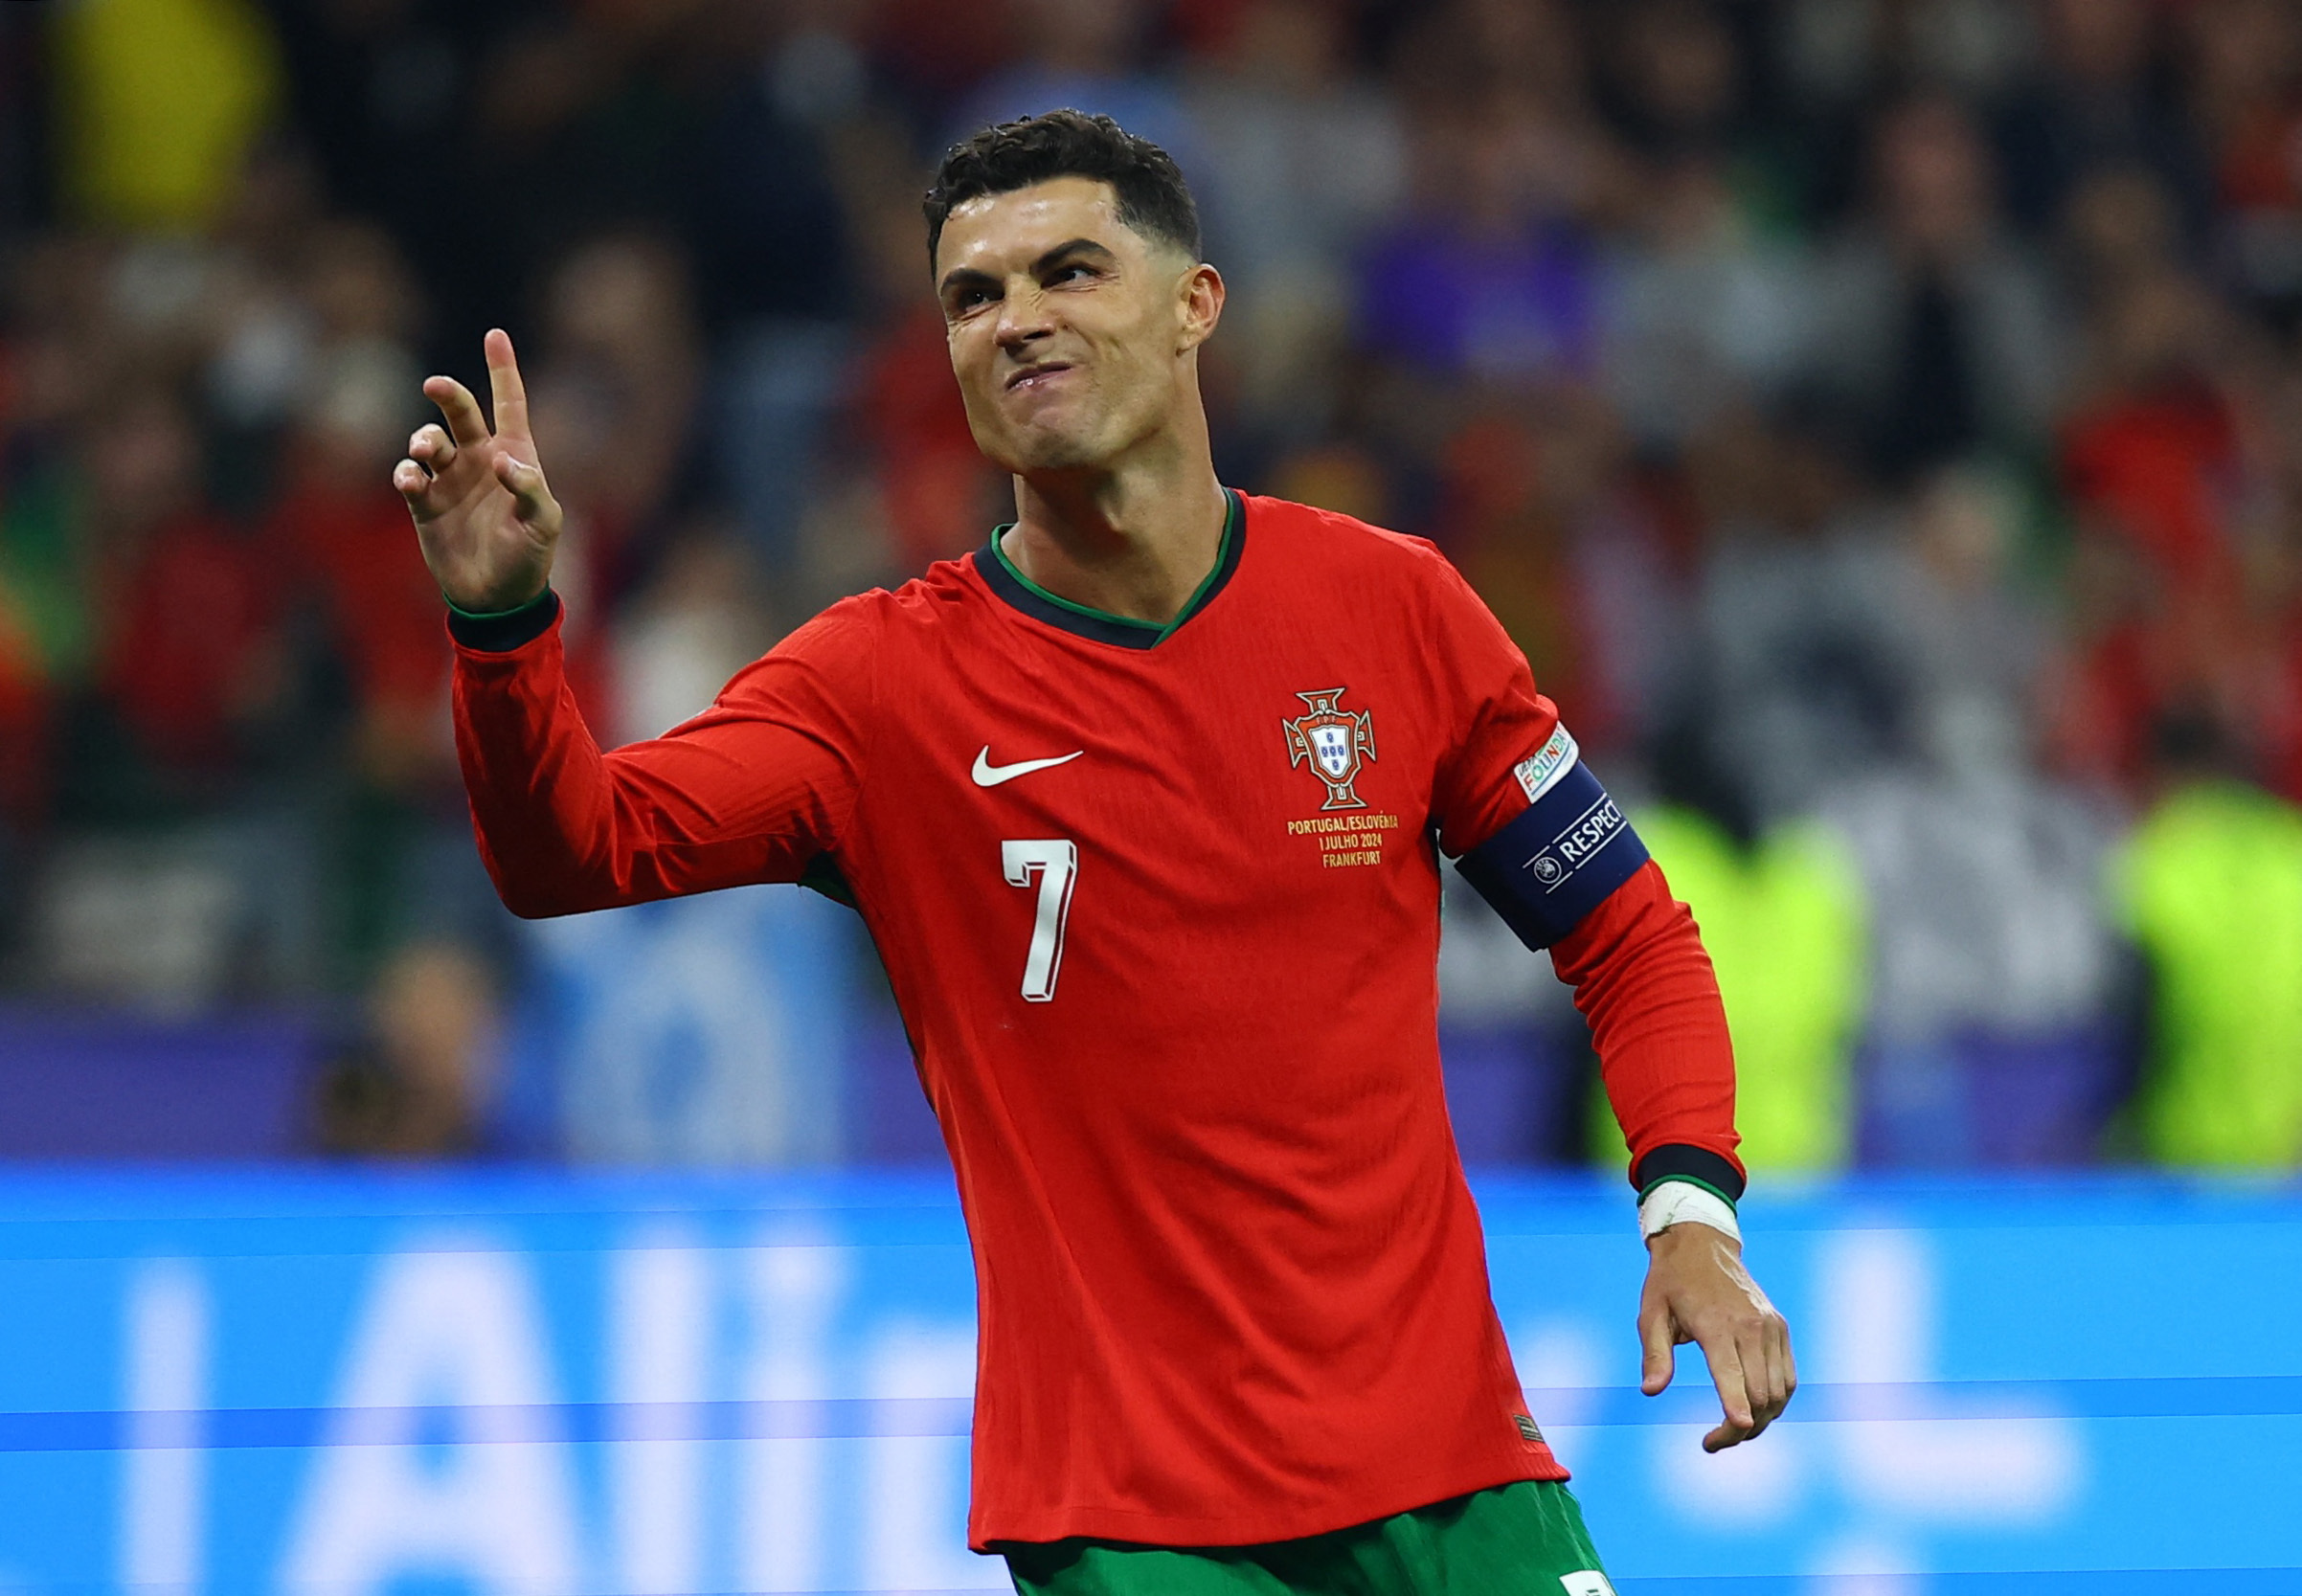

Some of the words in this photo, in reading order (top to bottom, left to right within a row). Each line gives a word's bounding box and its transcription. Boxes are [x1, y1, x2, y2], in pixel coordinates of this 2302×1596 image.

[1325, 834, 1359, 850] JULHO
[1361, 833, 1382, 848] 2024
[1559, 799, 1622, 863] RESPECT
[1322, 850, 1381, 868] FRANKFURT
[1001, 839, 1078, 1002] 7
